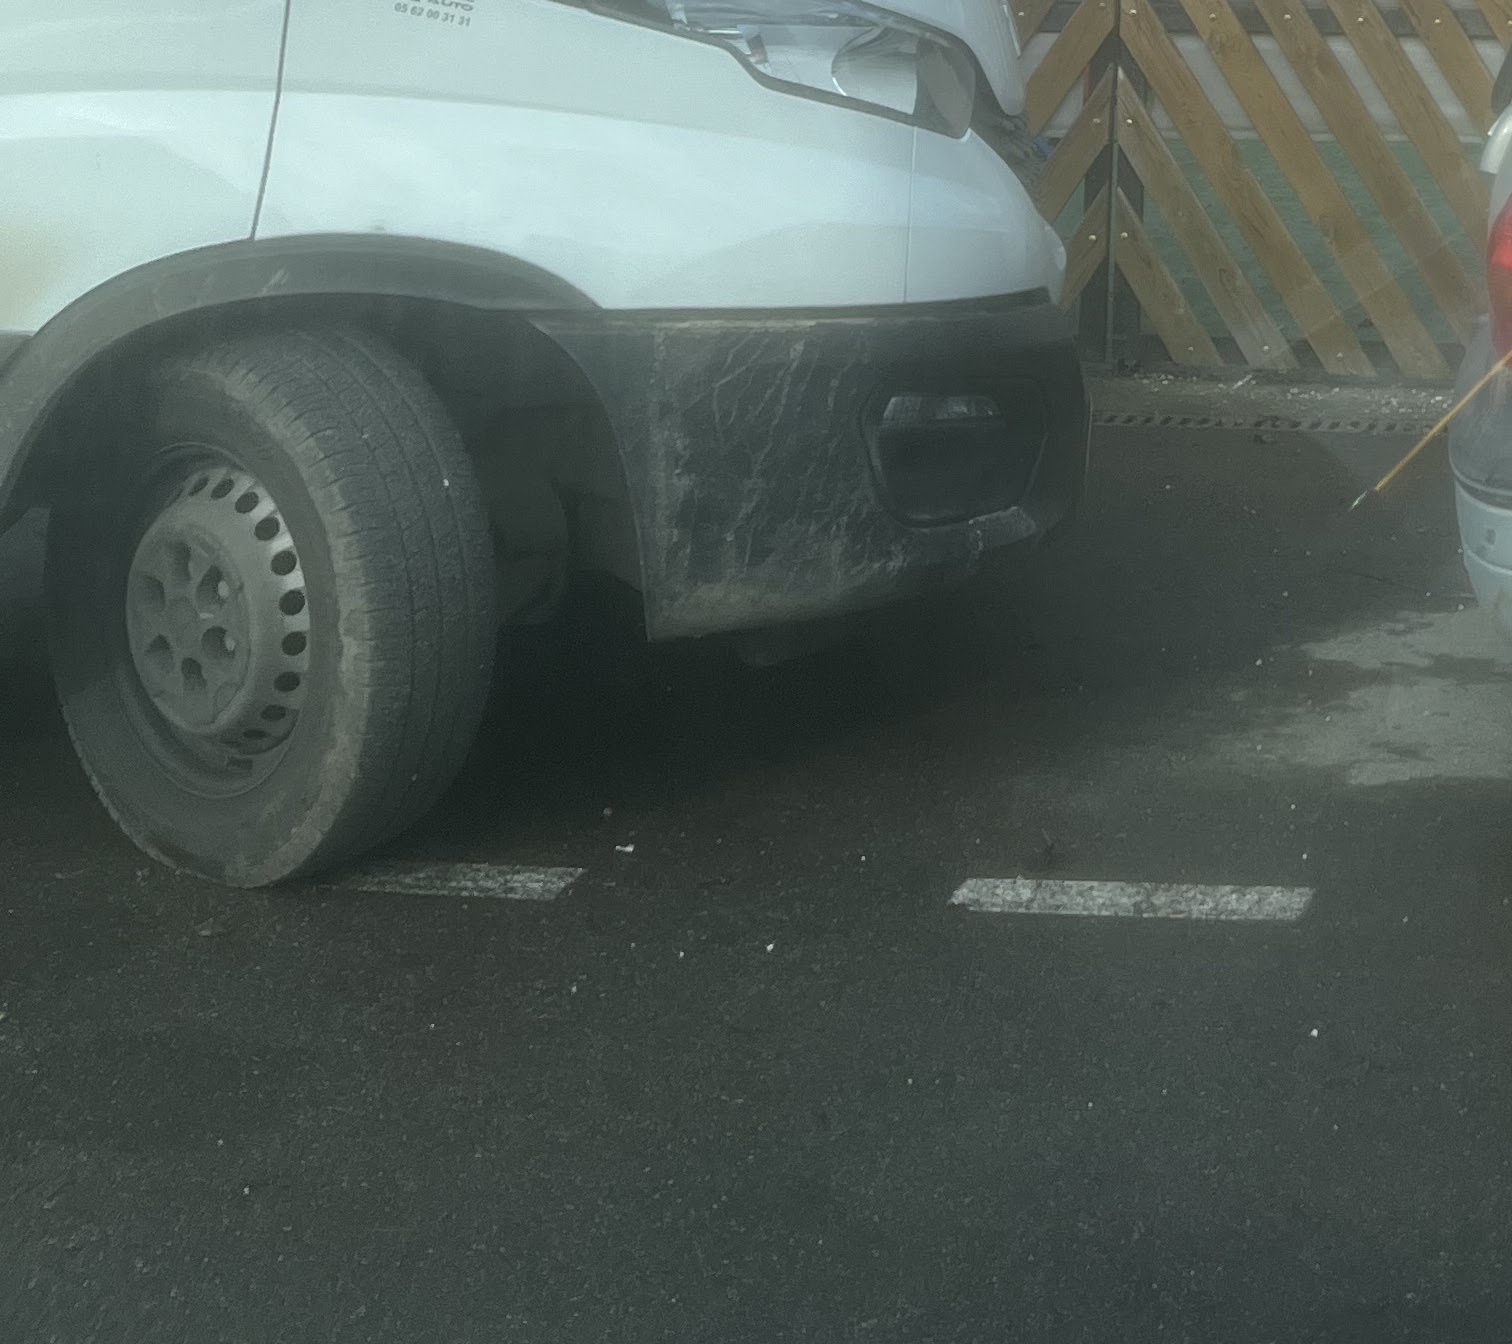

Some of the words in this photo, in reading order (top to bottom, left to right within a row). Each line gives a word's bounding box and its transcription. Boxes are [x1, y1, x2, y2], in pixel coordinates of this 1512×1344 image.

[394, 2, 408, 13] 05
[410, 5, 424, 16] 62
[426, 8, 440, 20] 00
[441, 12, 455, 23] 31
